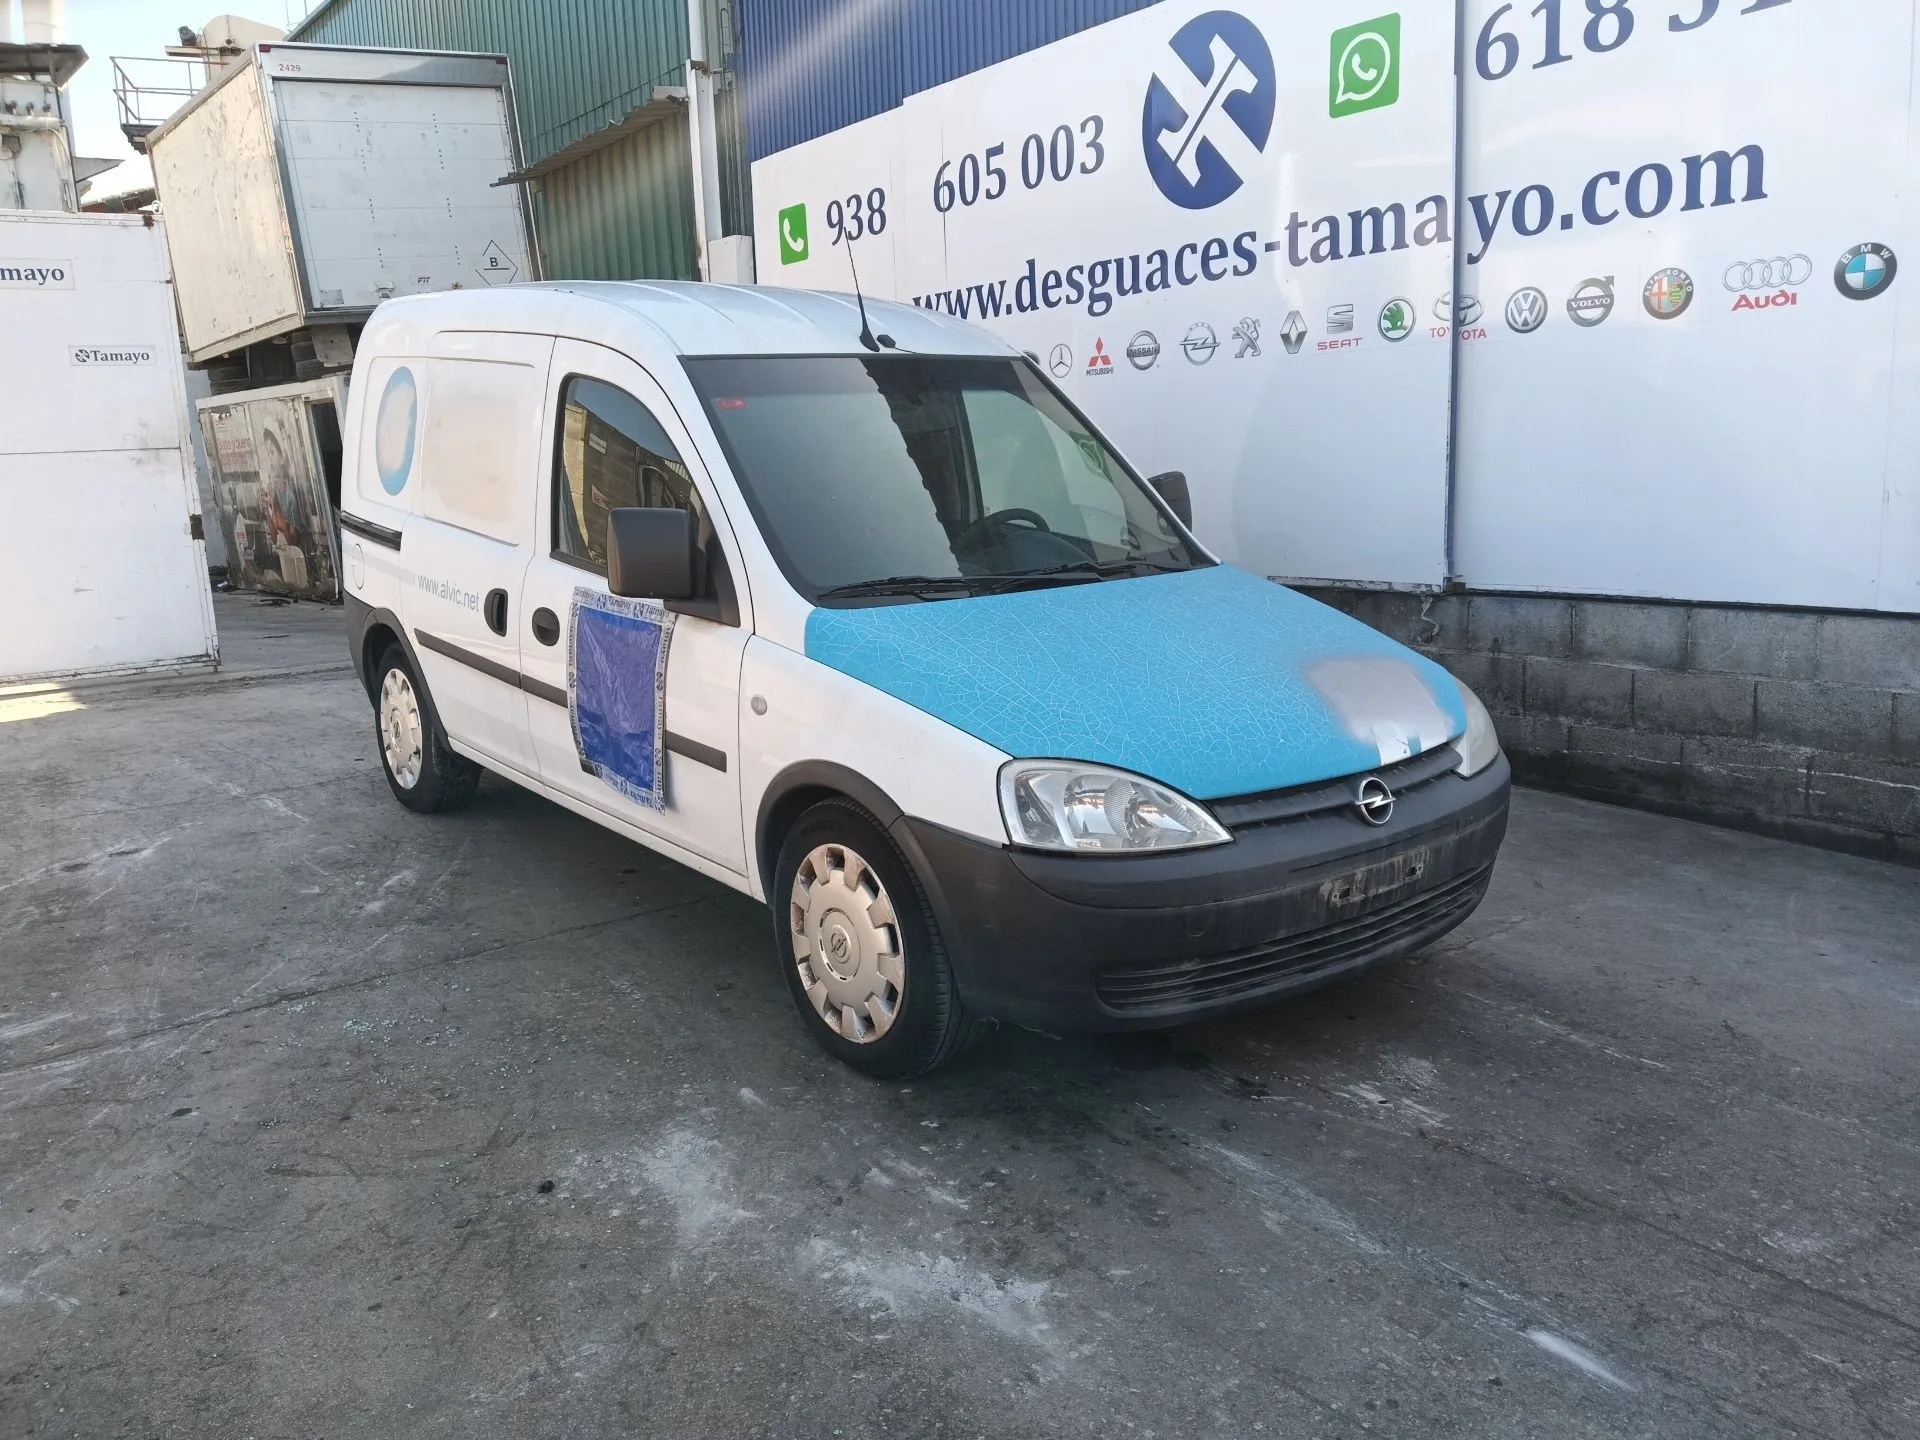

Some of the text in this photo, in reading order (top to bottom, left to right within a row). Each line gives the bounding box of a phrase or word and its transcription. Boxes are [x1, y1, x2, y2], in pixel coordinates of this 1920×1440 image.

[1475, 0, 1635, 81] 618
[278, 63, 301, 72] 2429
[826, 114, 1105, 246] 938 605 003
[1841, 244, 1892, 264] BMW
[489, 257, 499, 267] B
[1666, 269, 1693, 292] ROMEO
[1570, 297, 1611, 308] VOLVO
[1317, 337, 1363, 350] SEAT
[90, 350, 150, 364] Tamayo
[1086, 366, 1114, 376] MITSUBISHI
[417, 575, 480, 612] www.alvic.net
